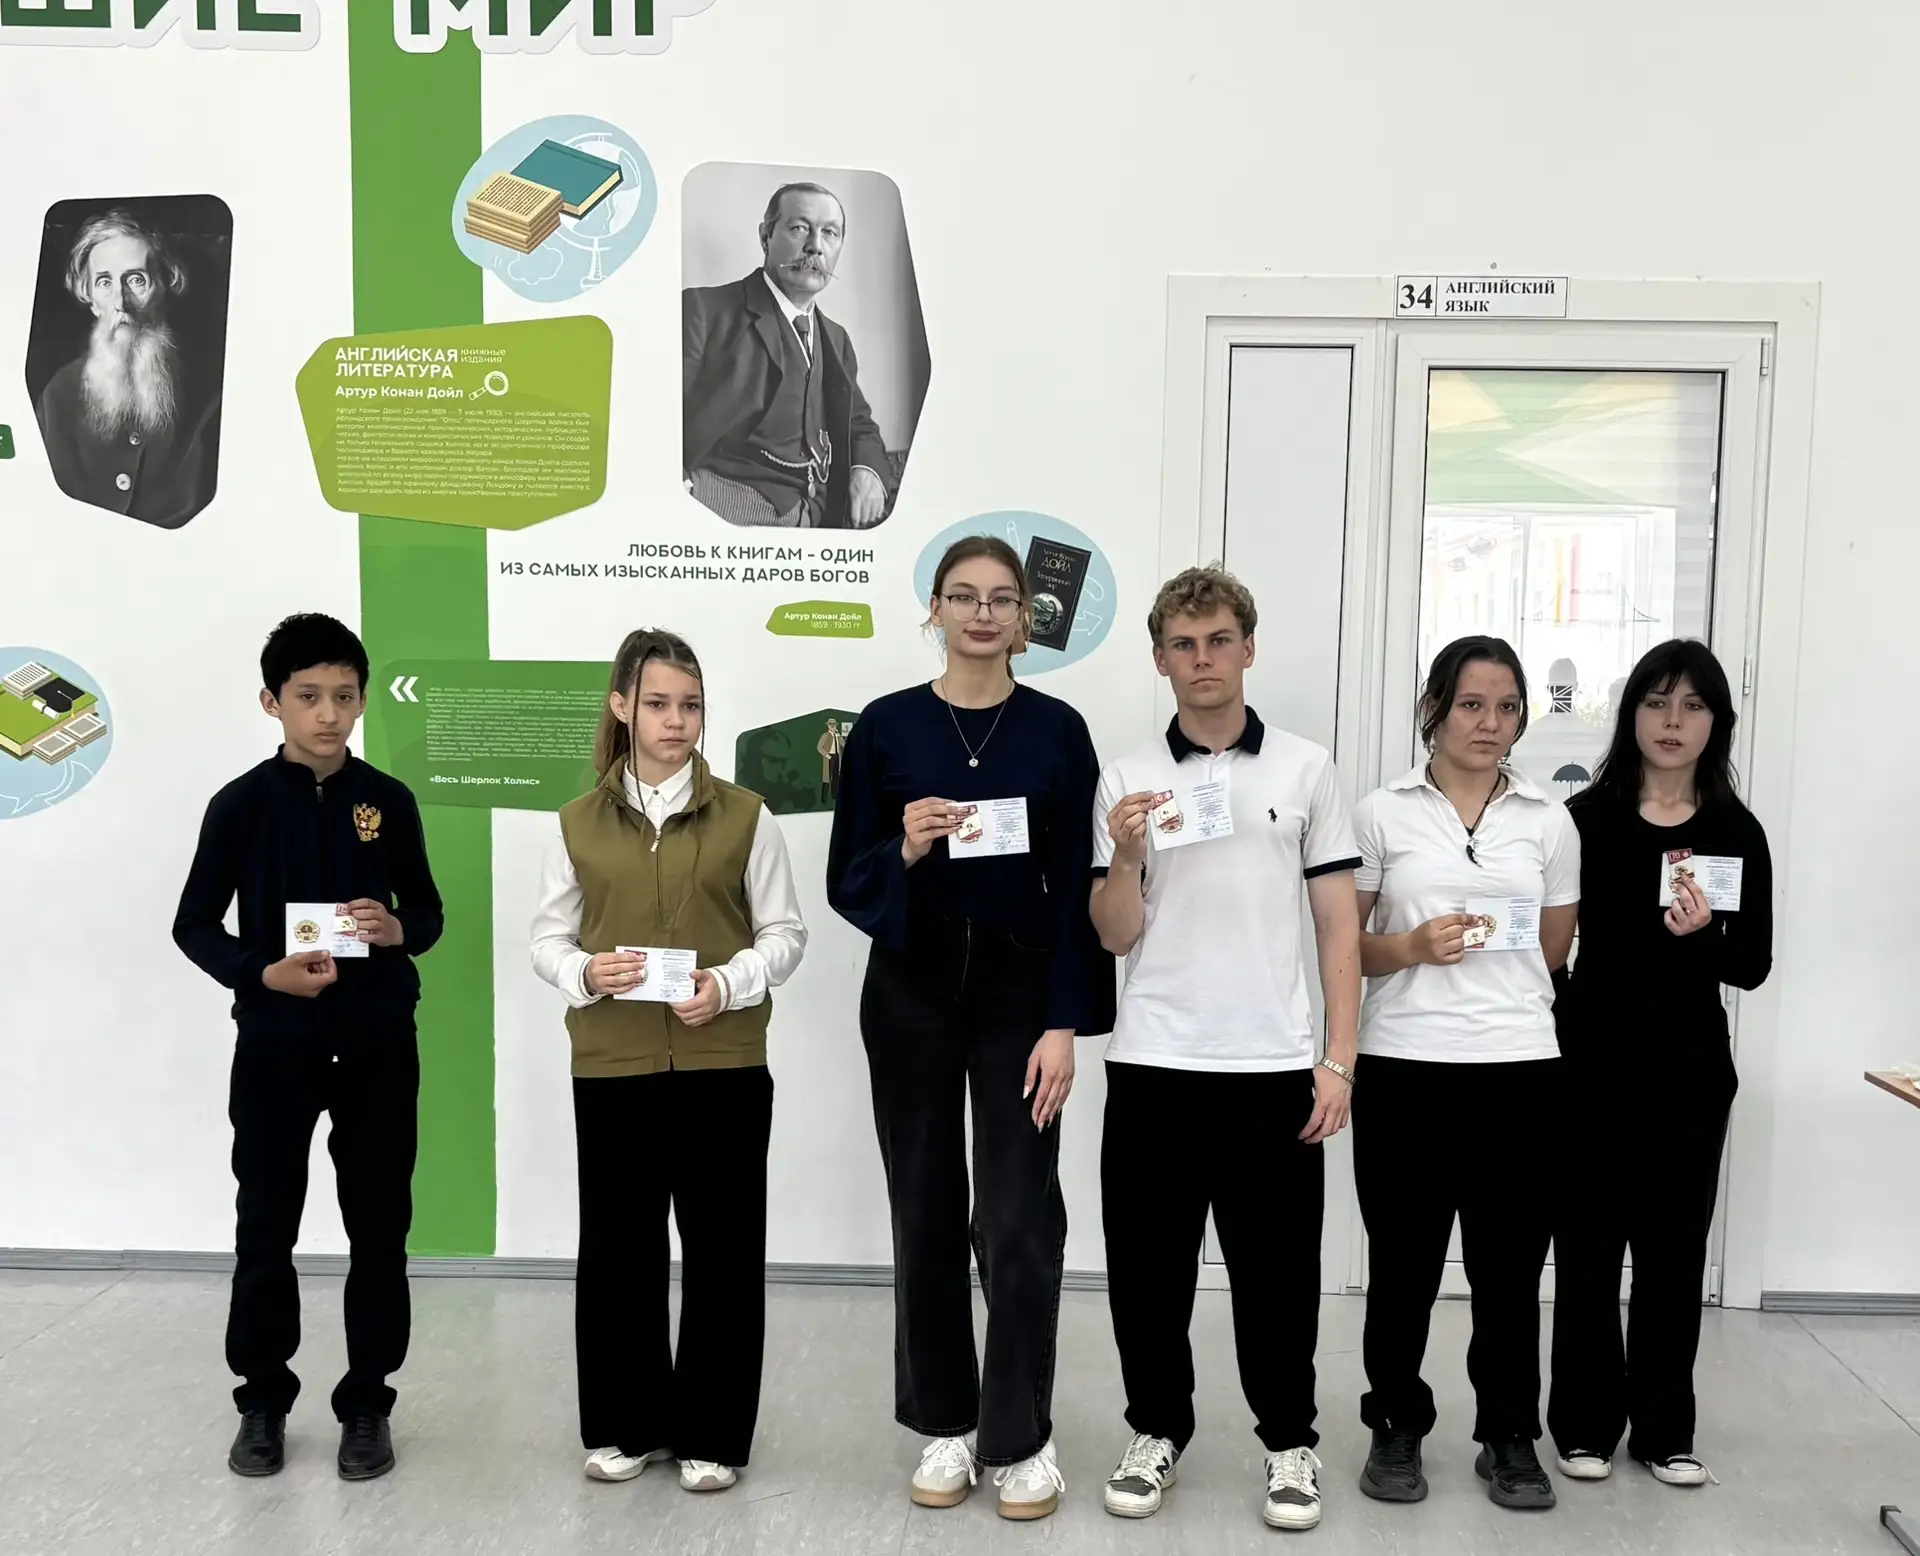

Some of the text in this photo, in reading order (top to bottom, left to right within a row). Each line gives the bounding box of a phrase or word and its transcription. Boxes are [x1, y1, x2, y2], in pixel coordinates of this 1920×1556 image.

[1399, 279, 1556, 309] 34 АНГЛИЙСКИЙ
[1444, 299, 1490, 312] ЯЗЫК
[335, 345, 458, 363] АНГЛИЙСКАЯ
[460, 356, 502, 364] издания
[335, 363, 454, 379] ЛИТЕРАТУРА
[335, 385, 464, 400] Артур Конан Дойл
[627, 544, 706, 559] ЛЮБОВЬ
[711, 546, 720, 559] К
[727, 547, 802, 561] КНИГАМ
[821, 548, 875, 563] ОДИН
[500, 562, 870, 584] ИЗ САМЫХ ИЗЫСКАННЫХ ДАРОВ БОГОВ
[784, 612, 810, 621] Артур
[839, 613, 862, 621] Дойл
[811, 621, 828, 629] 1859
[834, 621, 852, 629] 1930
[429, 775, 540, 785] «Весь Шерлок Холмс»
